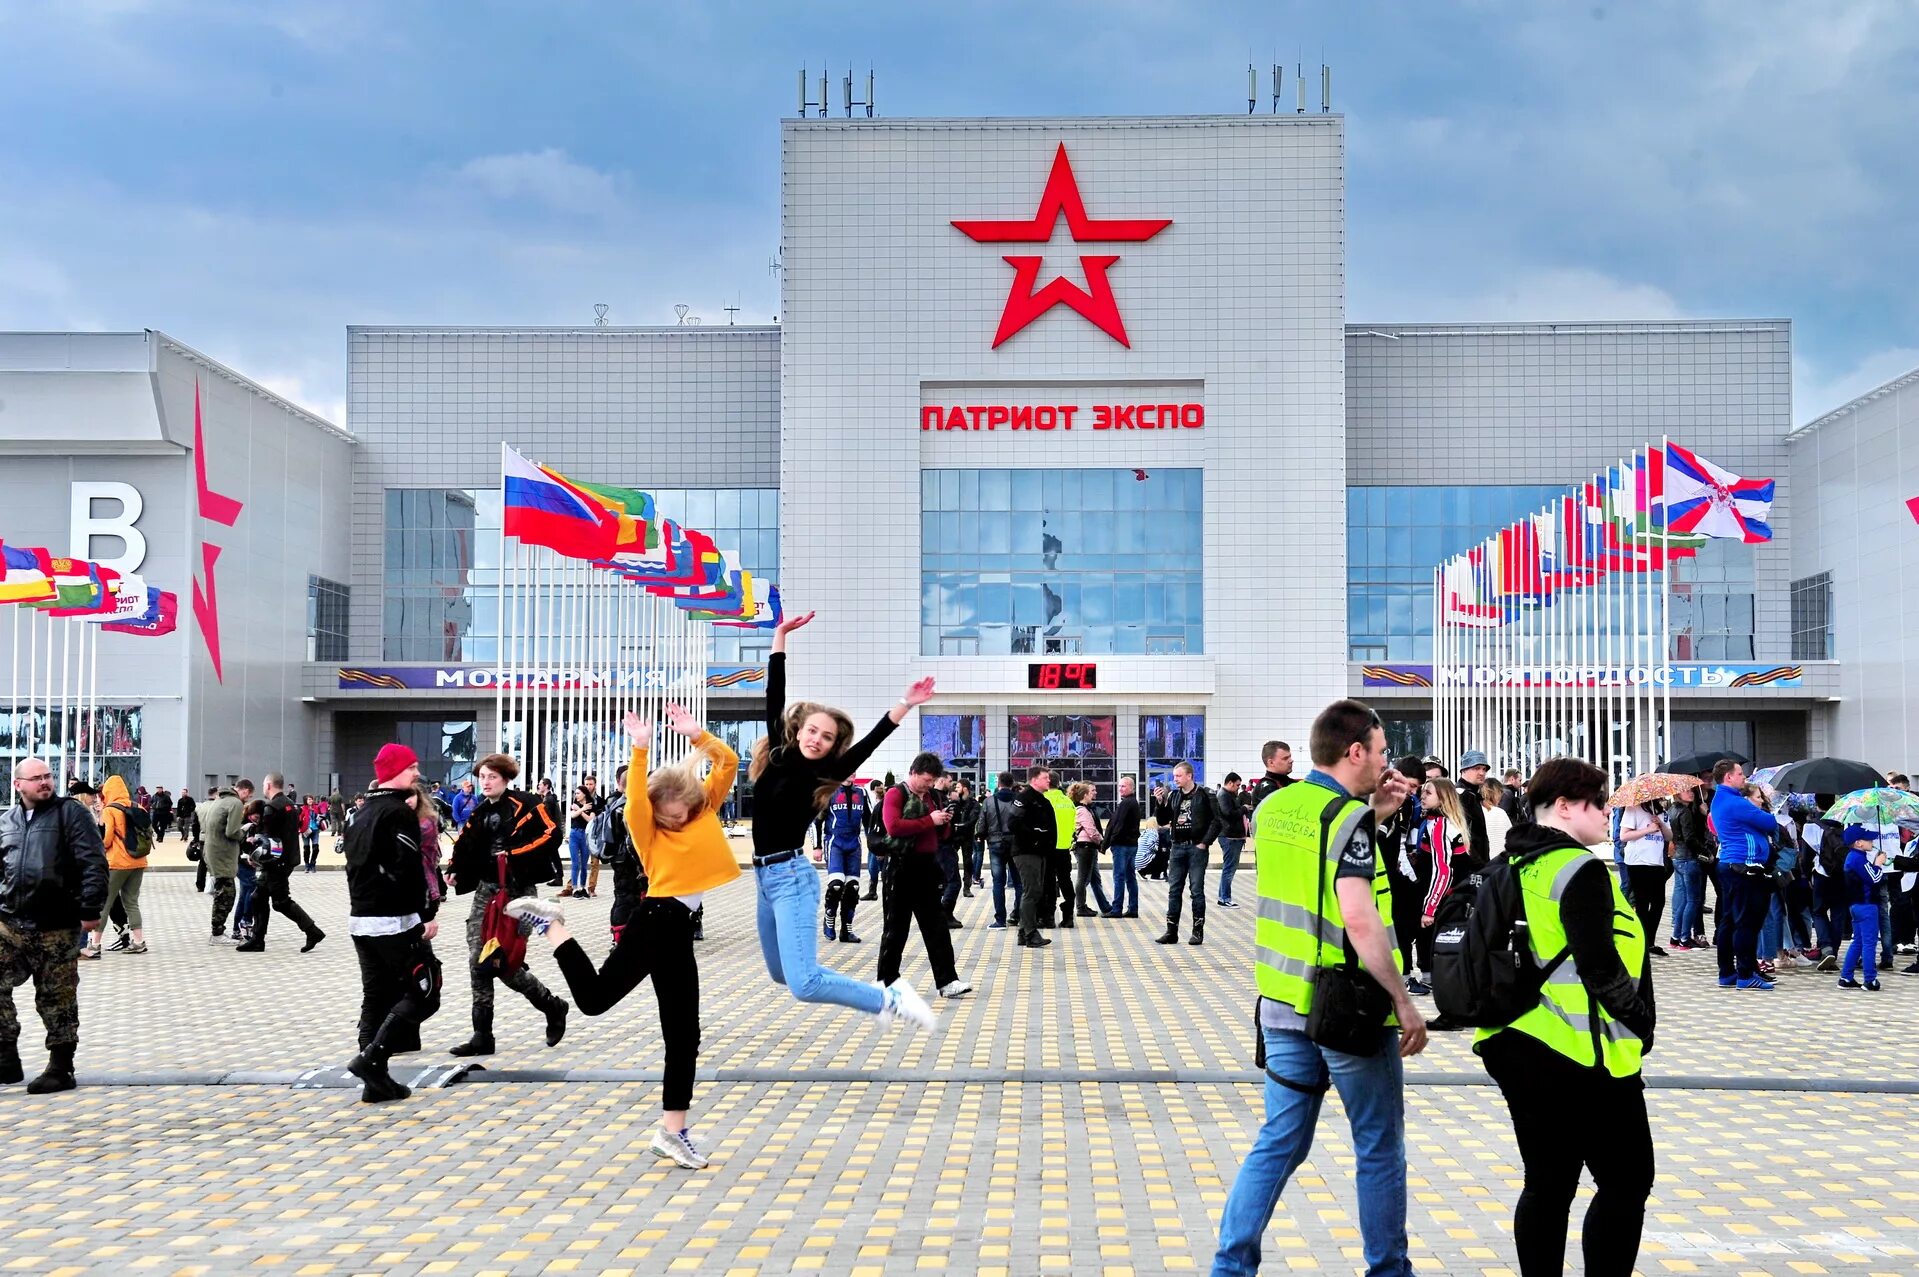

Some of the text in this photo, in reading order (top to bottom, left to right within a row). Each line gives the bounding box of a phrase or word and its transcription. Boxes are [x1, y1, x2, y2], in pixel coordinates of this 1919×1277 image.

[922, 403, 1205, 431] ПАТРИОТ ЭКСПО
[436, 669, 666, 687] МОЯ АРМИЯ
[832, 803, 864, 811] SUZUKI
